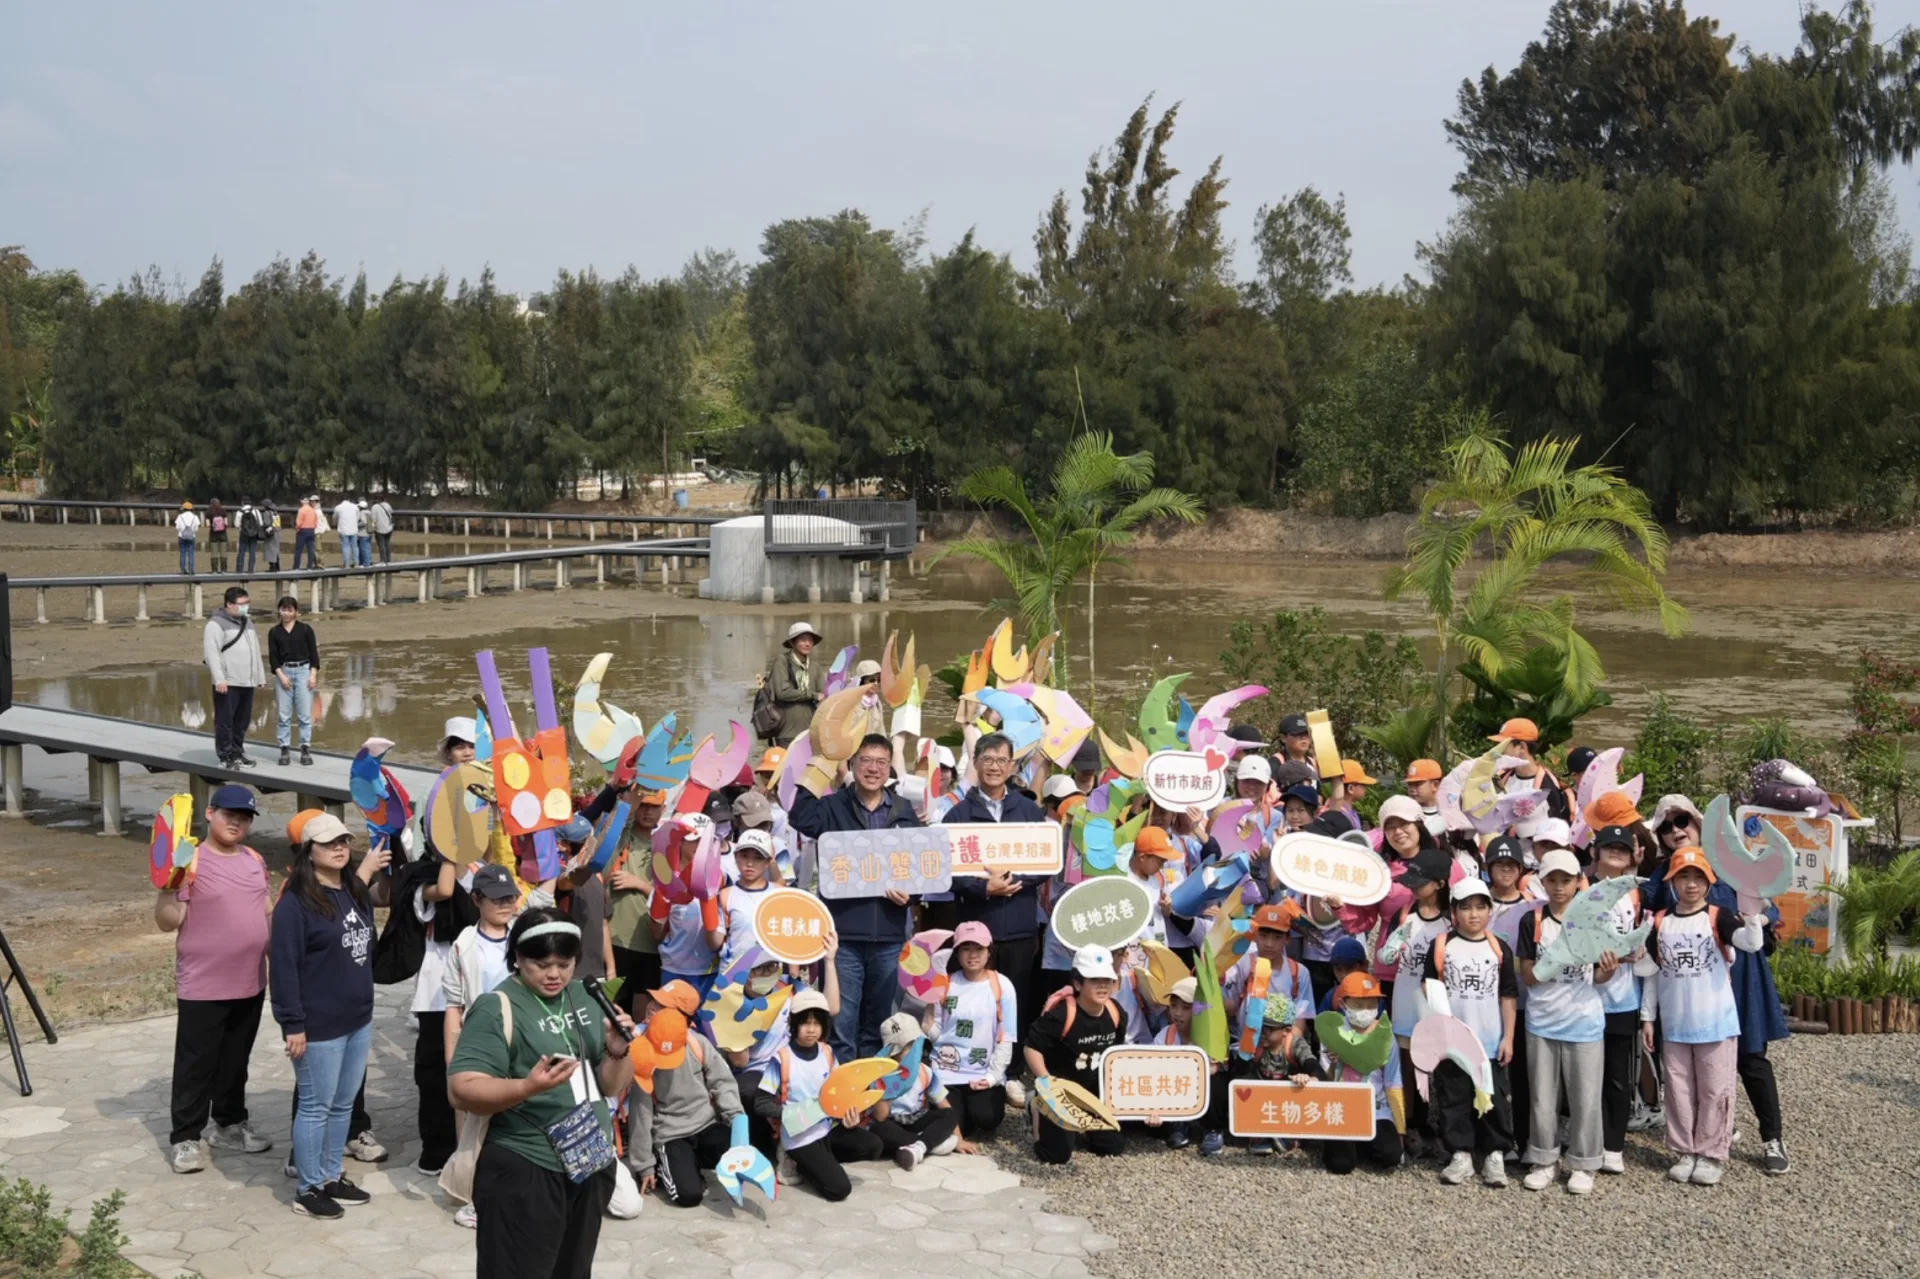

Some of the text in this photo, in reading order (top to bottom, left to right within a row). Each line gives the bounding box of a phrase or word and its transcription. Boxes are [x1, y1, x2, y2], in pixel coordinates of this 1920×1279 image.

[1154, 773, 1212, 790] 新竹市政府
[830, 850, 940, 884] 香山蟹田
[1294, 854, 1369, 888] 綠色旅遊
[767, 916, 821, 938] 生態永續
[1070, 898, 1135, 934] 棲地改善
[1677, 951, 1694, 969] 丙
[1465, 974, 1480, 991] 丙
[1118, 1075, 1192, 1097] 社區共好
[1260, 1100, 1345, 1126] 生物多樣
